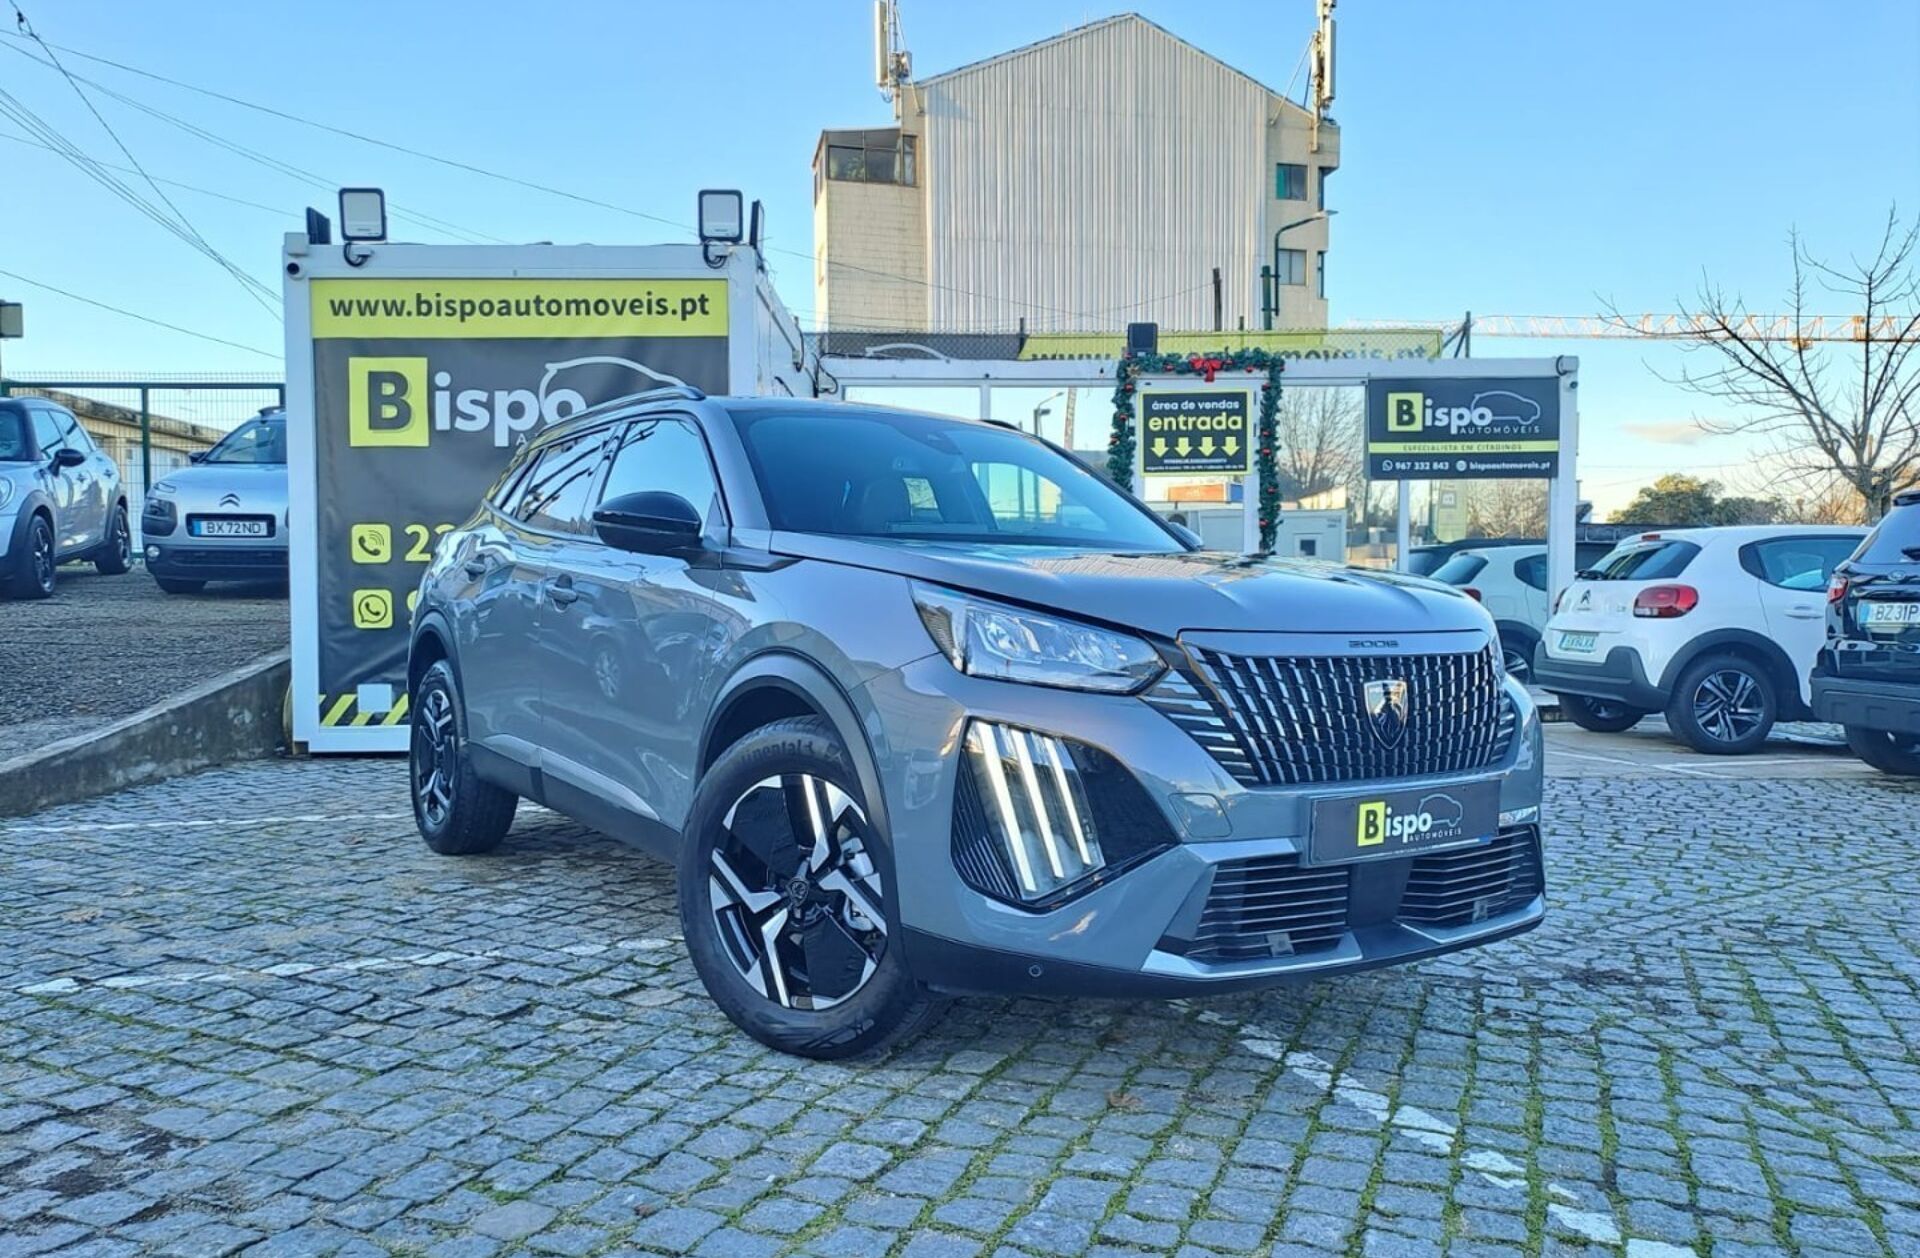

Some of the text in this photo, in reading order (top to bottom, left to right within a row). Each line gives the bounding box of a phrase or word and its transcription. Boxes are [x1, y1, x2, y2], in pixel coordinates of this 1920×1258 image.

[330, 291, 710, 322] www.bispoautomoveis.pt
[367, 370, 587, 447] Bispo
[1151, 400, 1240, 410] área de vendas
[1148, 411, 1242, 431] entrada
[1395, 398, 1493, 435] Bispo
[1460, 425, 1540, 435] AUTOMÓVEIS
[206, 521, 262, 534] BX72ND
[1348, 640, 1400, 648] 2008
[1364, 806, 1433, 844] Bispo
[1409, 828, 1462, 842] AUTOMÓVEIS
